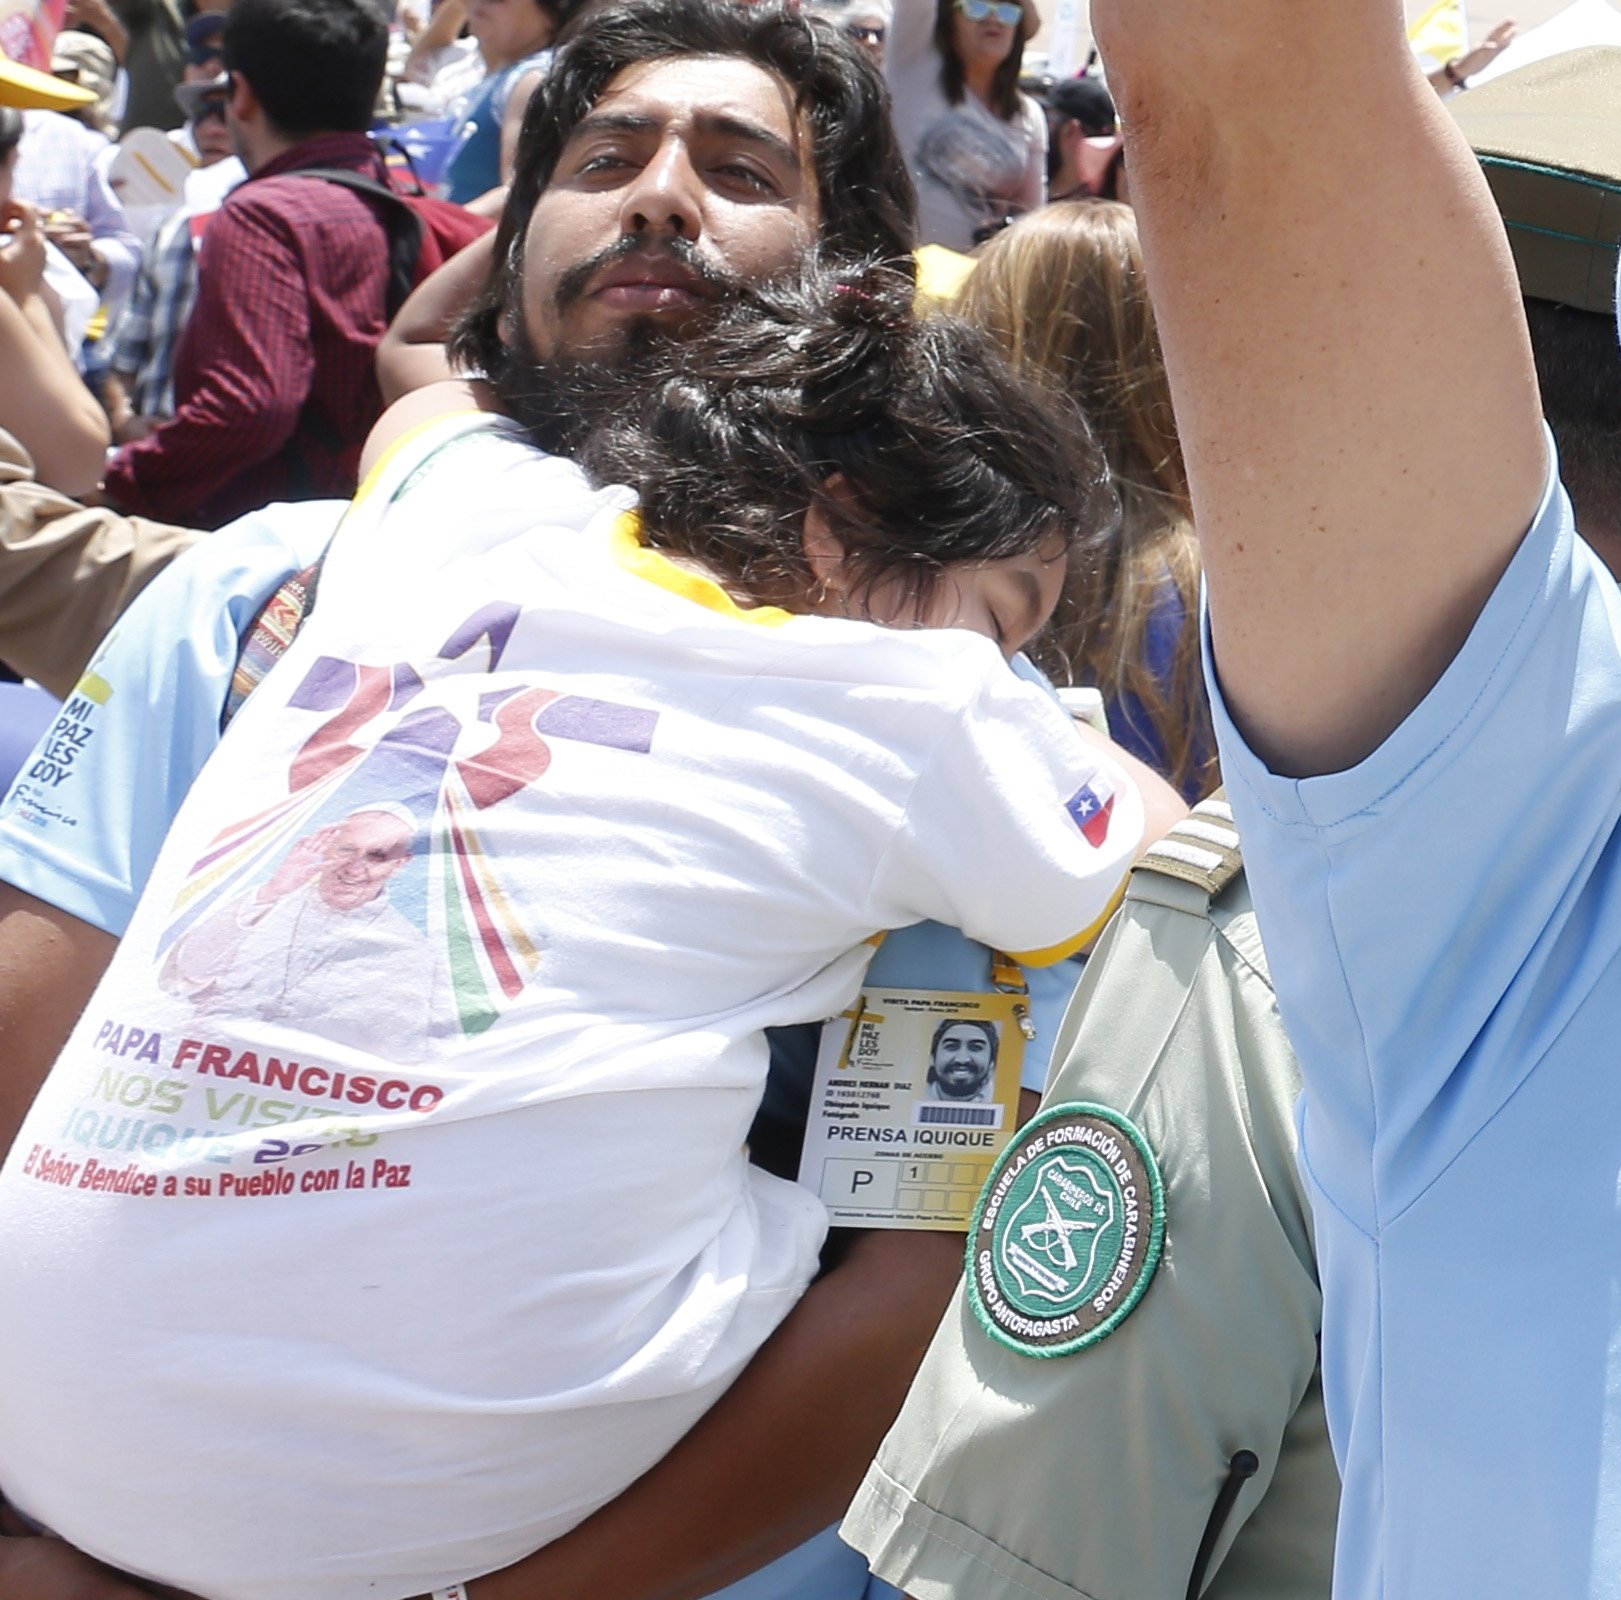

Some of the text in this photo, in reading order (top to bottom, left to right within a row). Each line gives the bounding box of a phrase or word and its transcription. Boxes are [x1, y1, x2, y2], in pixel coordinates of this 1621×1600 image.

[64, 697, 94, 723] MI
[51, 717, 94, 748] PAZ
[43, 737, 79, 765] LES
[28, 760, 74, 788] DOY
[933, 1000, 980, 1008] FRANCISCO
[861, 1031, 880, 1040] PAZ
[862, 1023, 874, 1031] MI
[858, 1048, 879, 1056] DOY
[859, 1040, 878, 1048] LES
[93, 1020, 445, 1113] PAPA FRANCISCO
[91, 1066, 188, 1114] NOS
[894, 1082, 912, 1090] DIAZ
[827, 1126, 994, 1146] PRENSA IQUIQUE
[35, 1149, 80, 1187] Señor
[78, 1158, 157, 1196] Bendice
[163, 1175, 177, 1196] a
[184, 1173, 211, 1197] su
[219, 1167, 295, 1197] Pueblo
[301, 1169, 339, 1192] con
[346, 1161, 364, 1189] la
[372, 1159, 411, 1188] Paz
[851, 1171, 873, 1194] P
[910, 1166, 917, 1178] 1
[1047, 1168, 1106, 1216] CARABINEROS DE
[1059, 1190, 1082, 1211] CHILE
[982, 1125, 1139, 1312] ESCUELA DE FORMACIÓN DE CARABINEROS
[979, 1250, 1080, 1338] GRUPO ANTOFAGASTA
